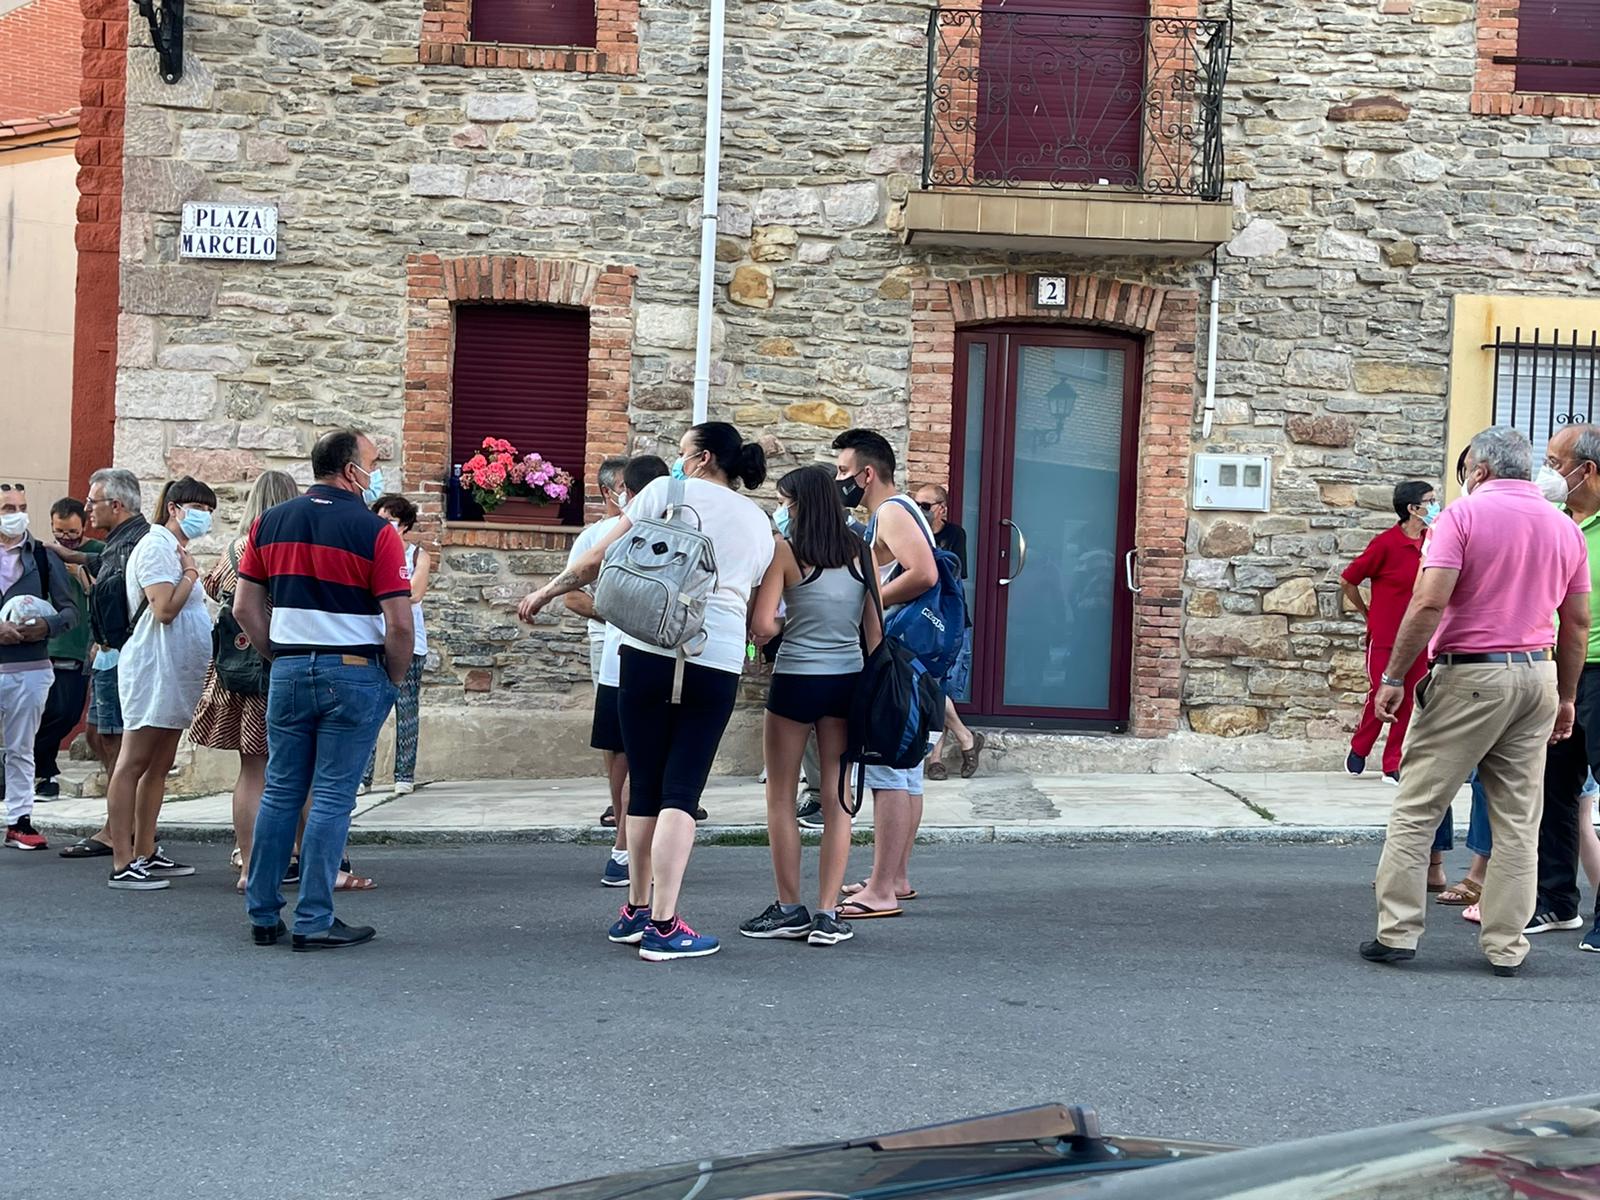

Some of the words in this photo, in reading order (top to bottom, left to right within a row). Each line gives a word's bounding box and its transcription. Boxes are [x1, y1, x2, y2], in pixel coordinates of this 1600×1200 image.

[196, 209, 262, 229] PLAZA
[182, 234, 275, 255] MARCELO
[1046, 281, 1058, 300] 2
